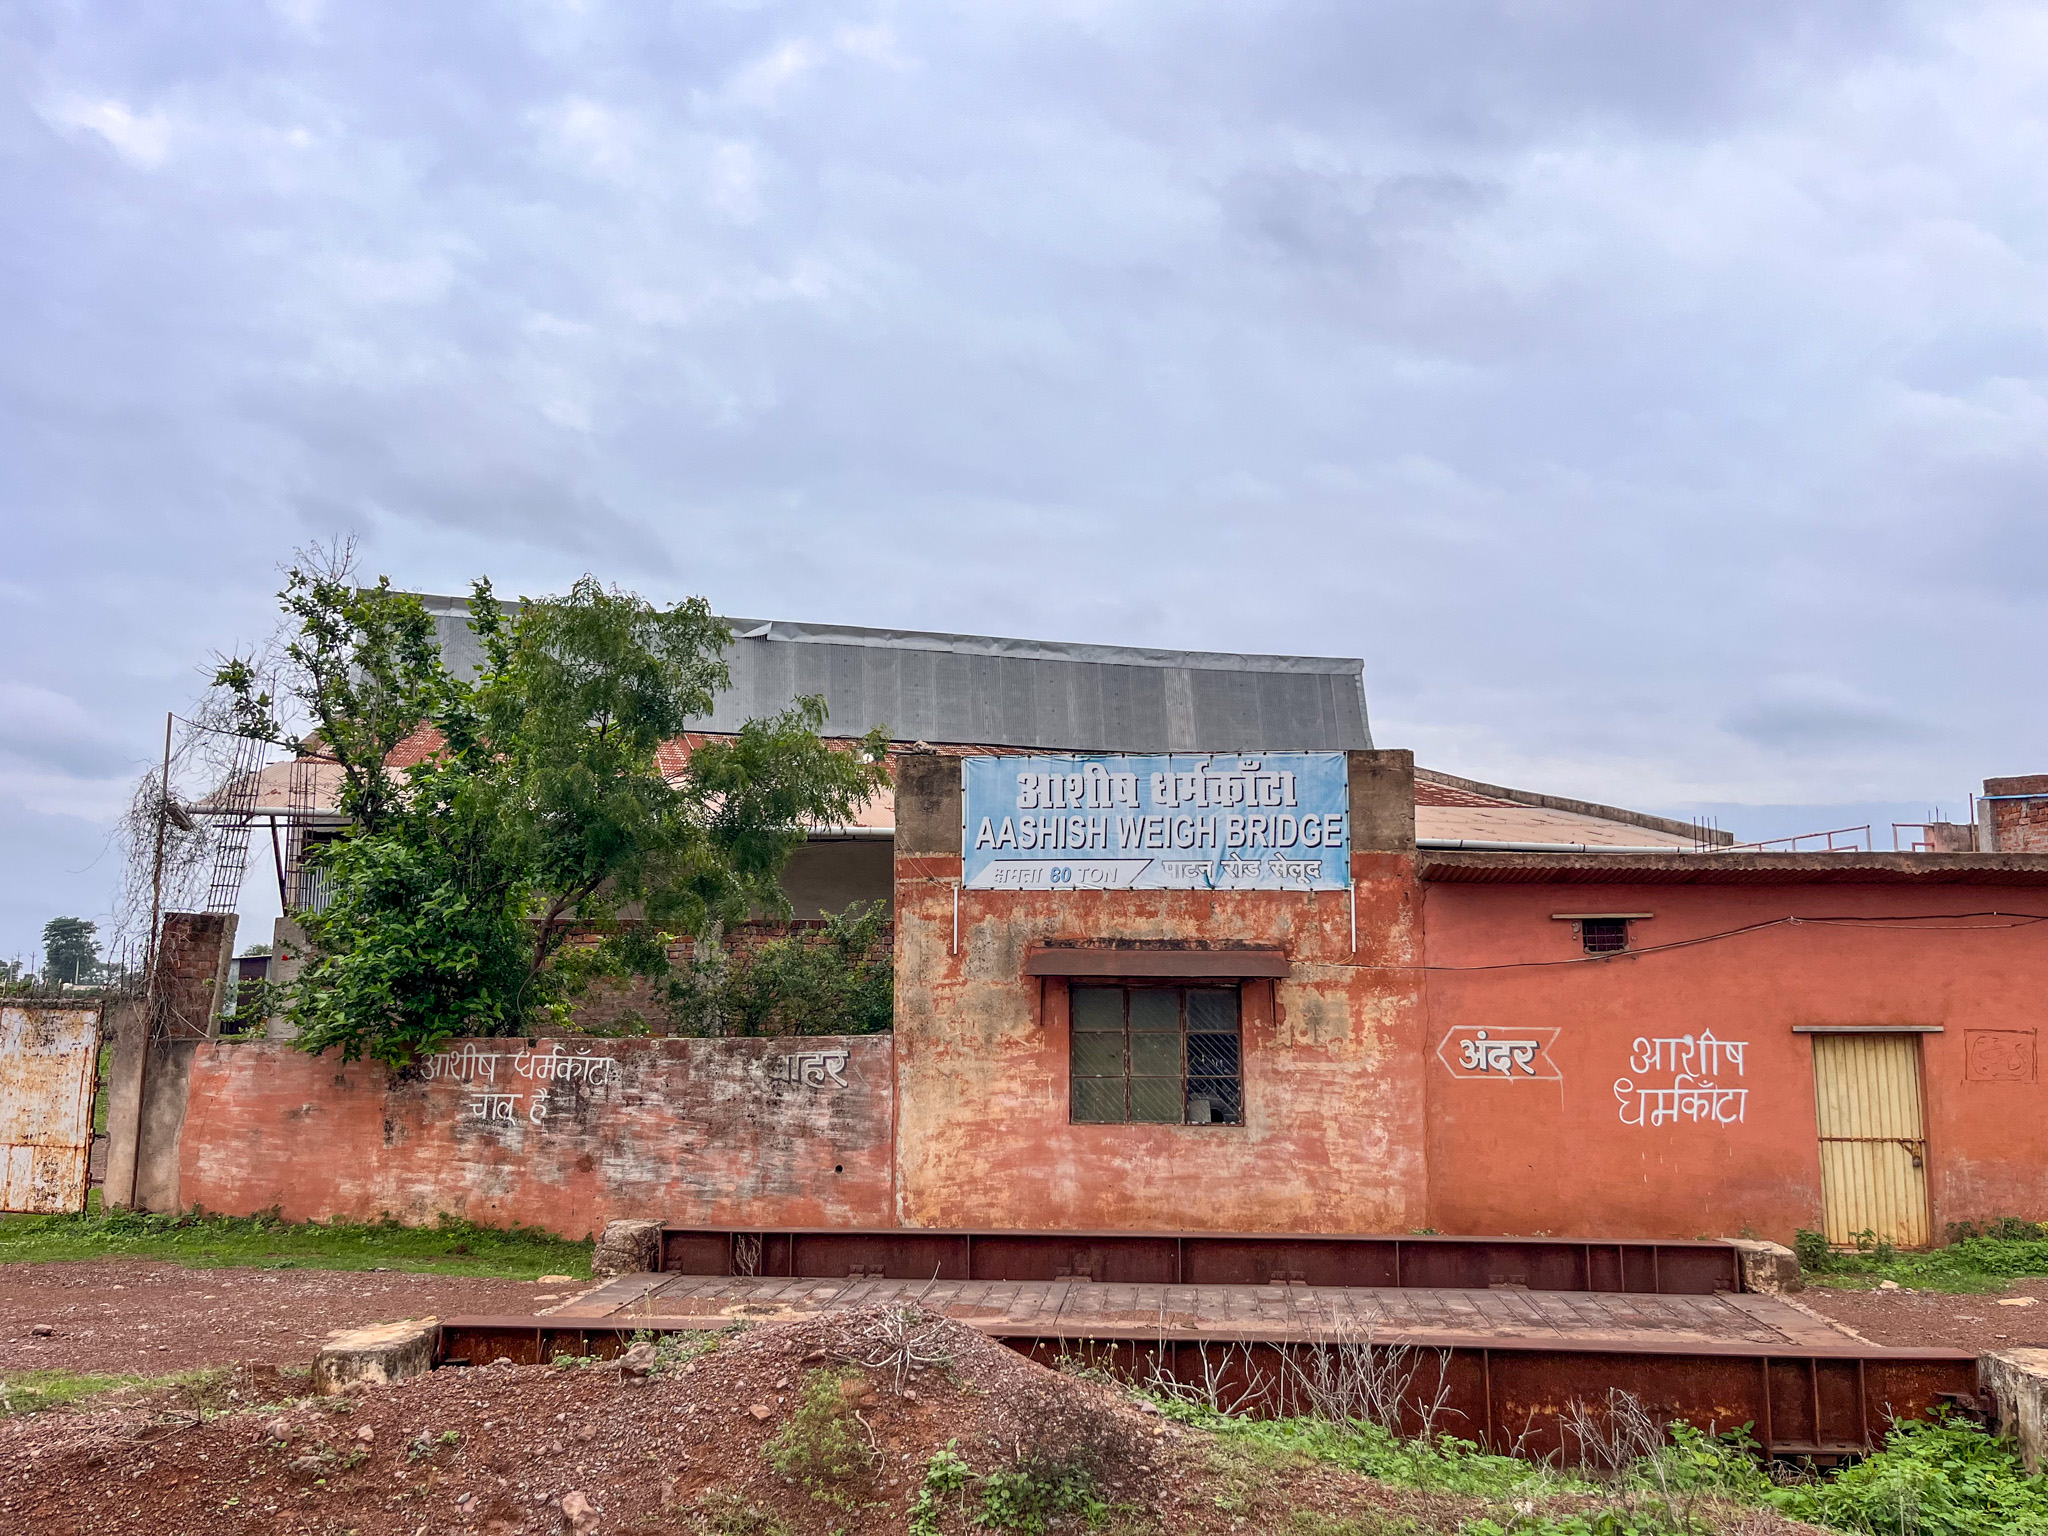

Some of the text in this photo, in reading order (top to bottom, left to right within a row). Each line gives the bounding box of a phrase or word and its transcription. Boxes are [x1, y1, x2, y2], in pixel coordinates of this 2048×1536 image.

[1017, 763, 1140, 809] आशीष
[976, 813, 1343, 850] AASHISH WEIGH BRIDGE
[1079, 867, 1118, 883] TON
[1162, 851, 1323, 884] पाटन रोड सेलूद
[419, 1042, 501, 1083] आशीष
[1459, 1030, 1539, 1076] अंदर
[1630, 1028, 1749, 1078] आशीष
[529, 1087, 551, 1124] है
